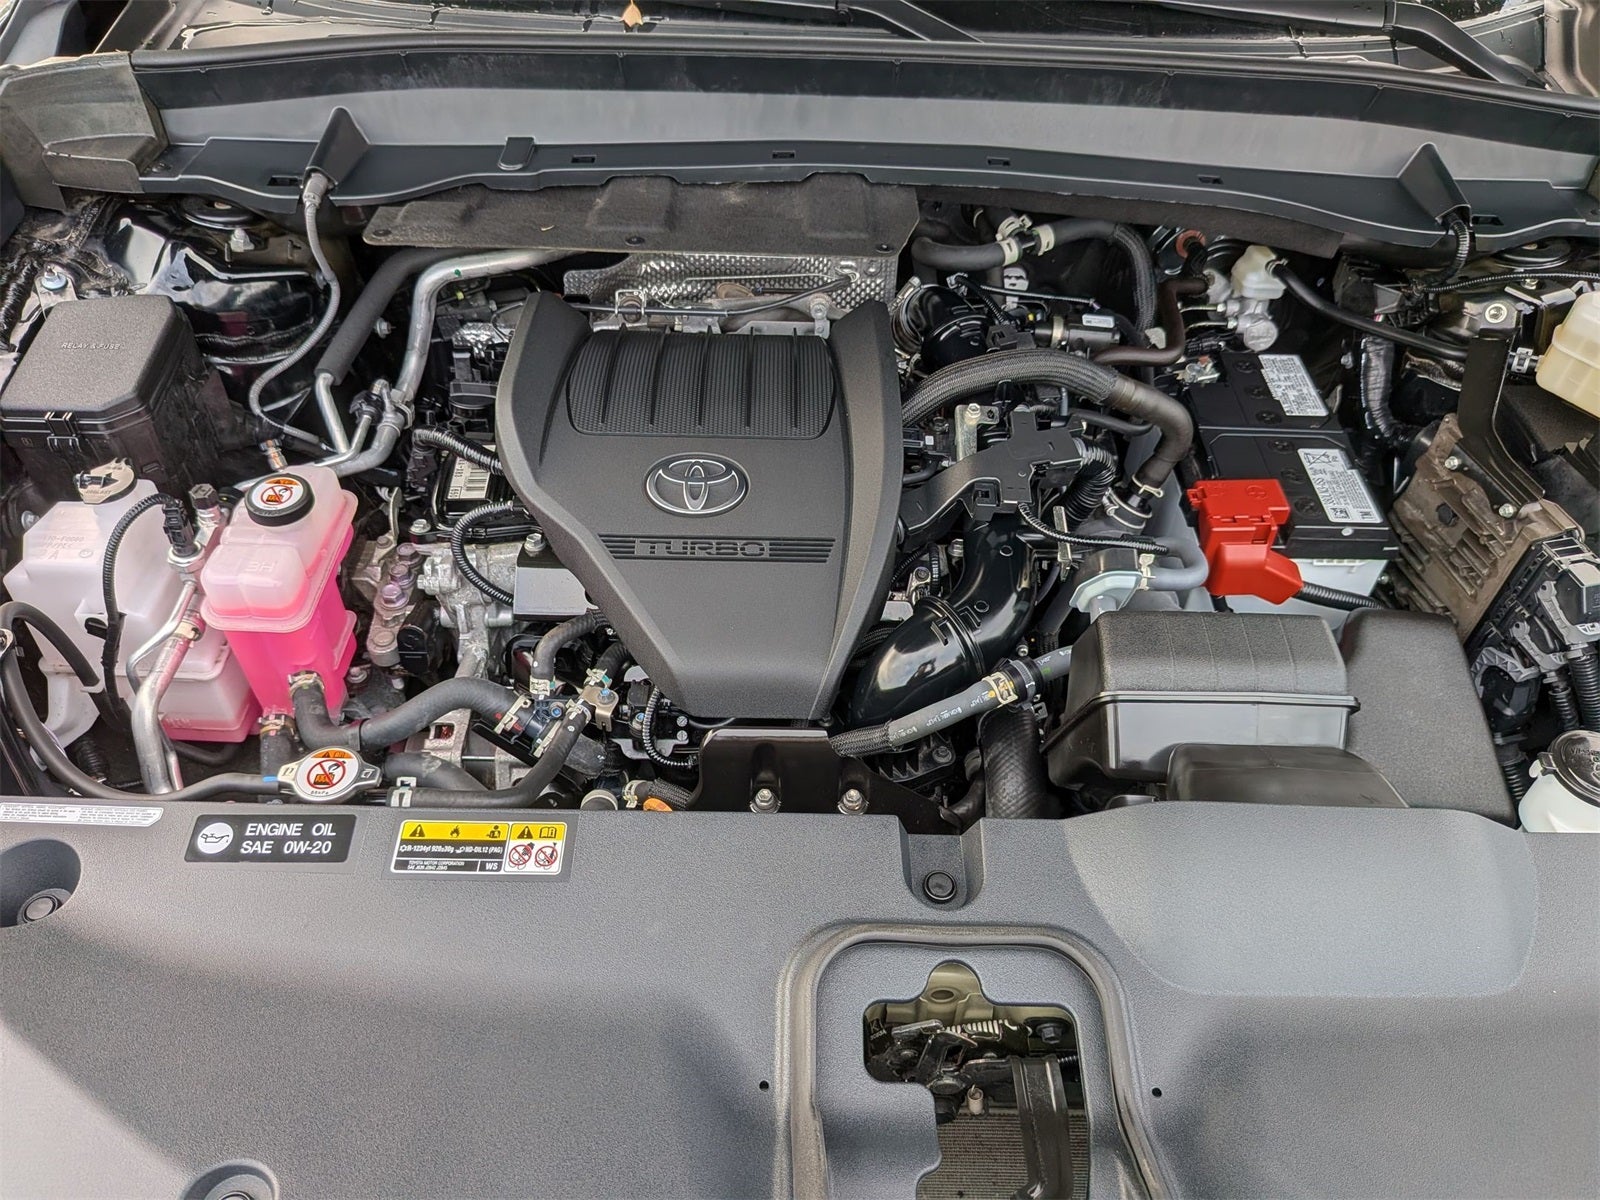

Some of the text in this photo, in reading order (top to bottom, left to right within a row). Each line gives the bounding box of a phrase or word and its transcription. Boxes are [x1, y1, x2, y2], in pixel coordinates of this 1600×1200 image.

[638, 539, 766, 558] TURBO
[245, 823, 337, 836] ENGINE OIL
[240, 841, 332, 854] SAE 0W-20
[485, 862, 499, 871] WS
